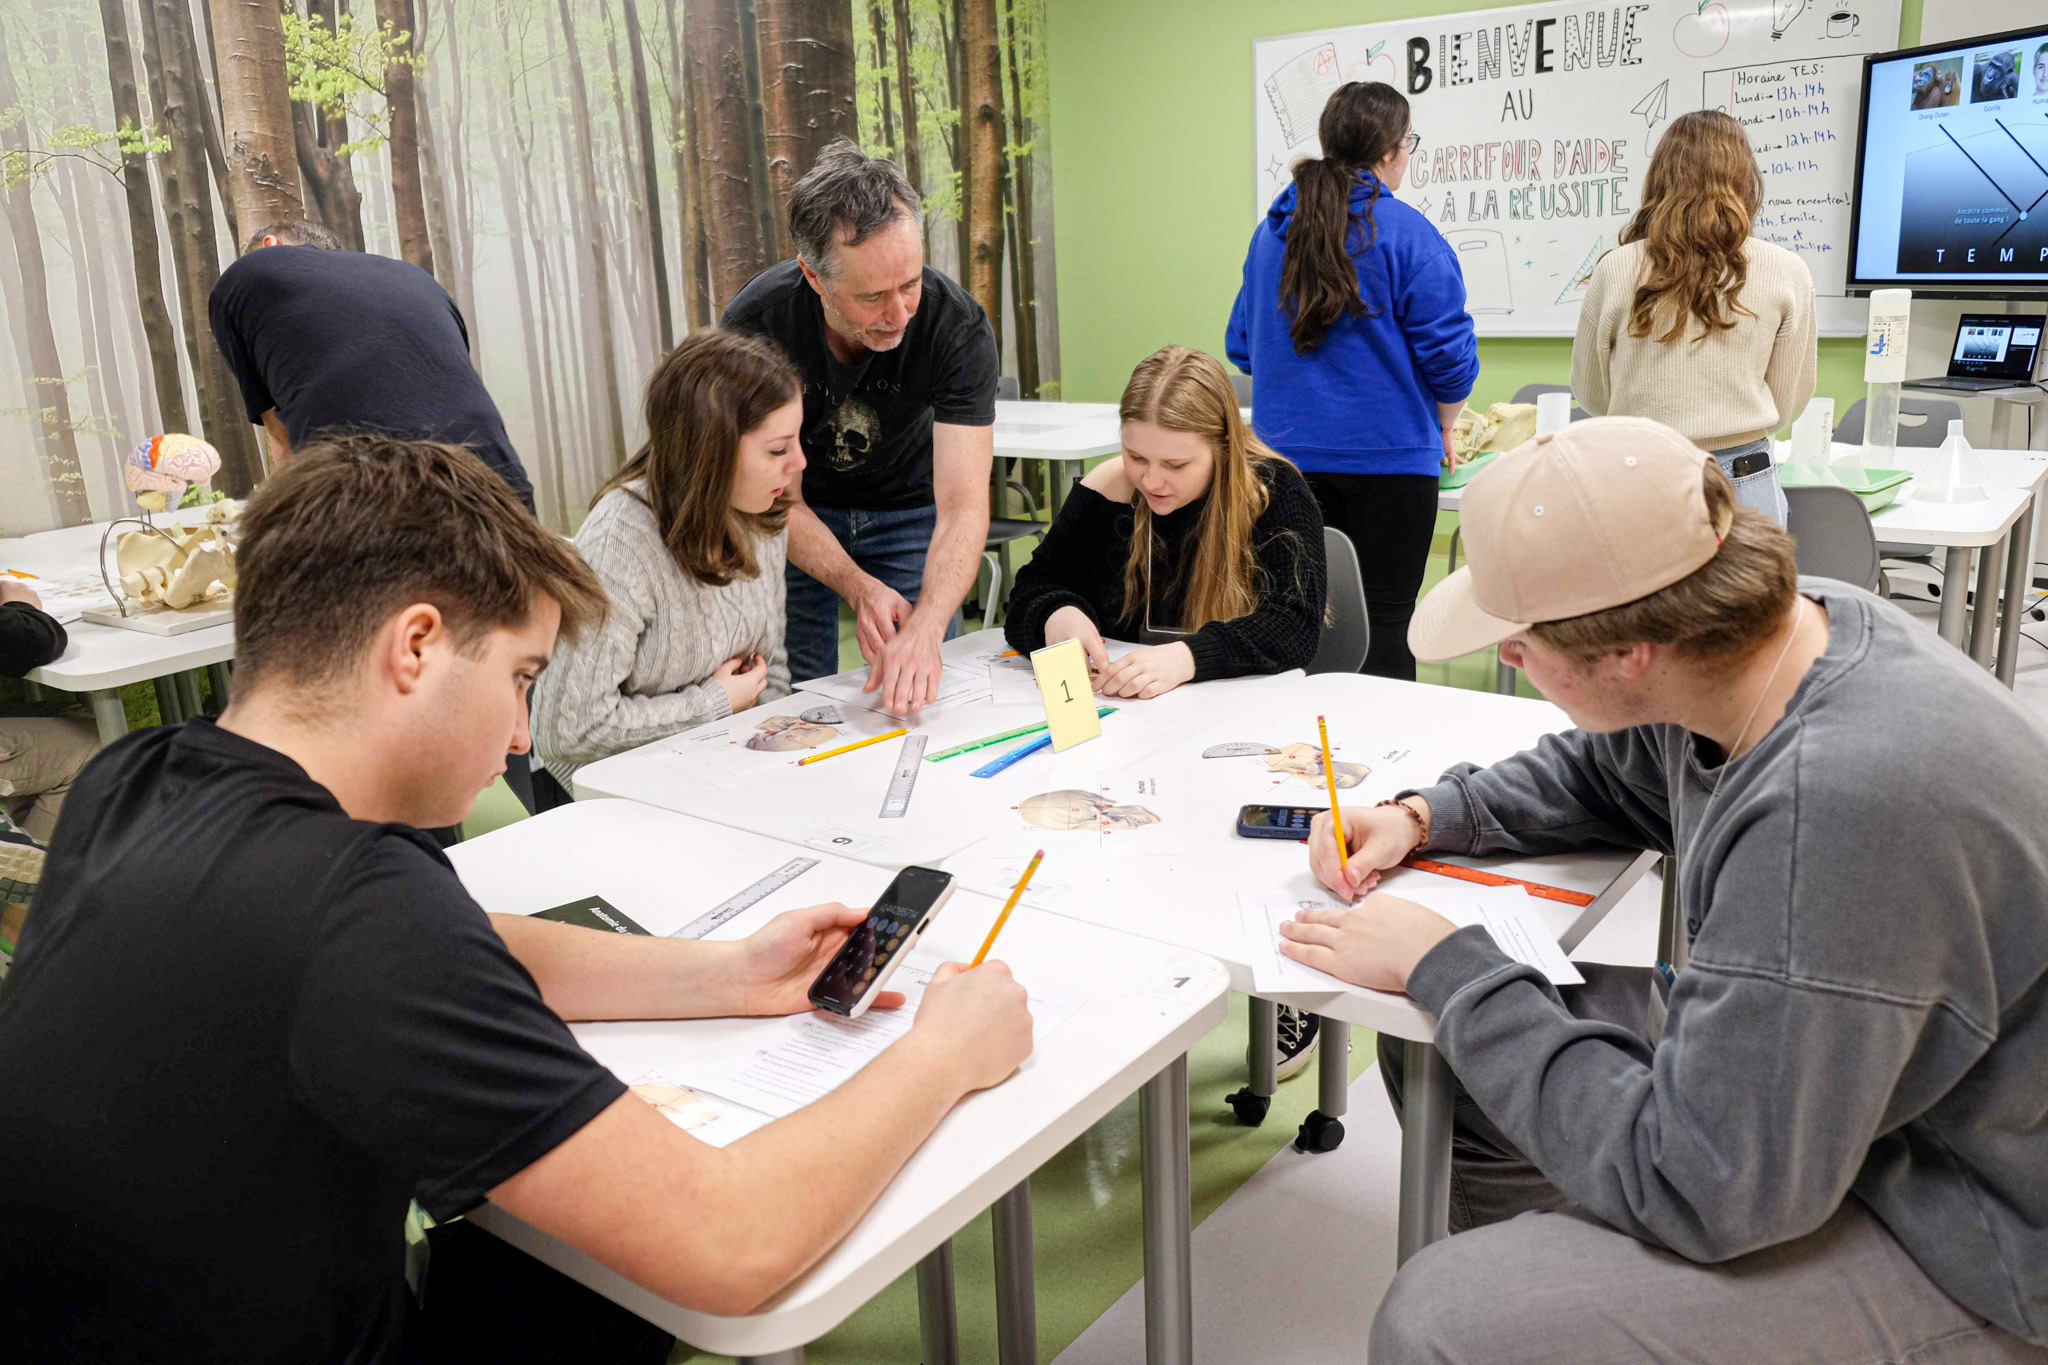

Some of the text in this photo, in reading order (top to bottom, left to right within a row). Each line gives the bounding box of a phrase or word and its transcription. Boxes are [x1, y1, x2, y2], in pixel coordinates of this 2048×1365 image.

[1406, 4, 1650, 95] BIENVENUE
[1737, 63, 1824, 85] Horaire TES:
[1735, 82, 1825, 104] Lundi 13h-14h
[1501, 88, 1533, 123] AU
[1779, 101, 1830, 122] 10h-14h
[1786, 130, 1836, 148] 12h-14h
[1409, 138, 1628, 189] CARREFOUR D'AIDE
[1772, 160, 1819, 174] 10h-11h
[1468, 190, 1499, 221] LA
[1509, 176, 1630, 220] RÉUSSITE
[1793, 229, 1803, 241] et
[1060, 680, 1074, 703] 1
[588, 907, 619, 927] Anatomie
